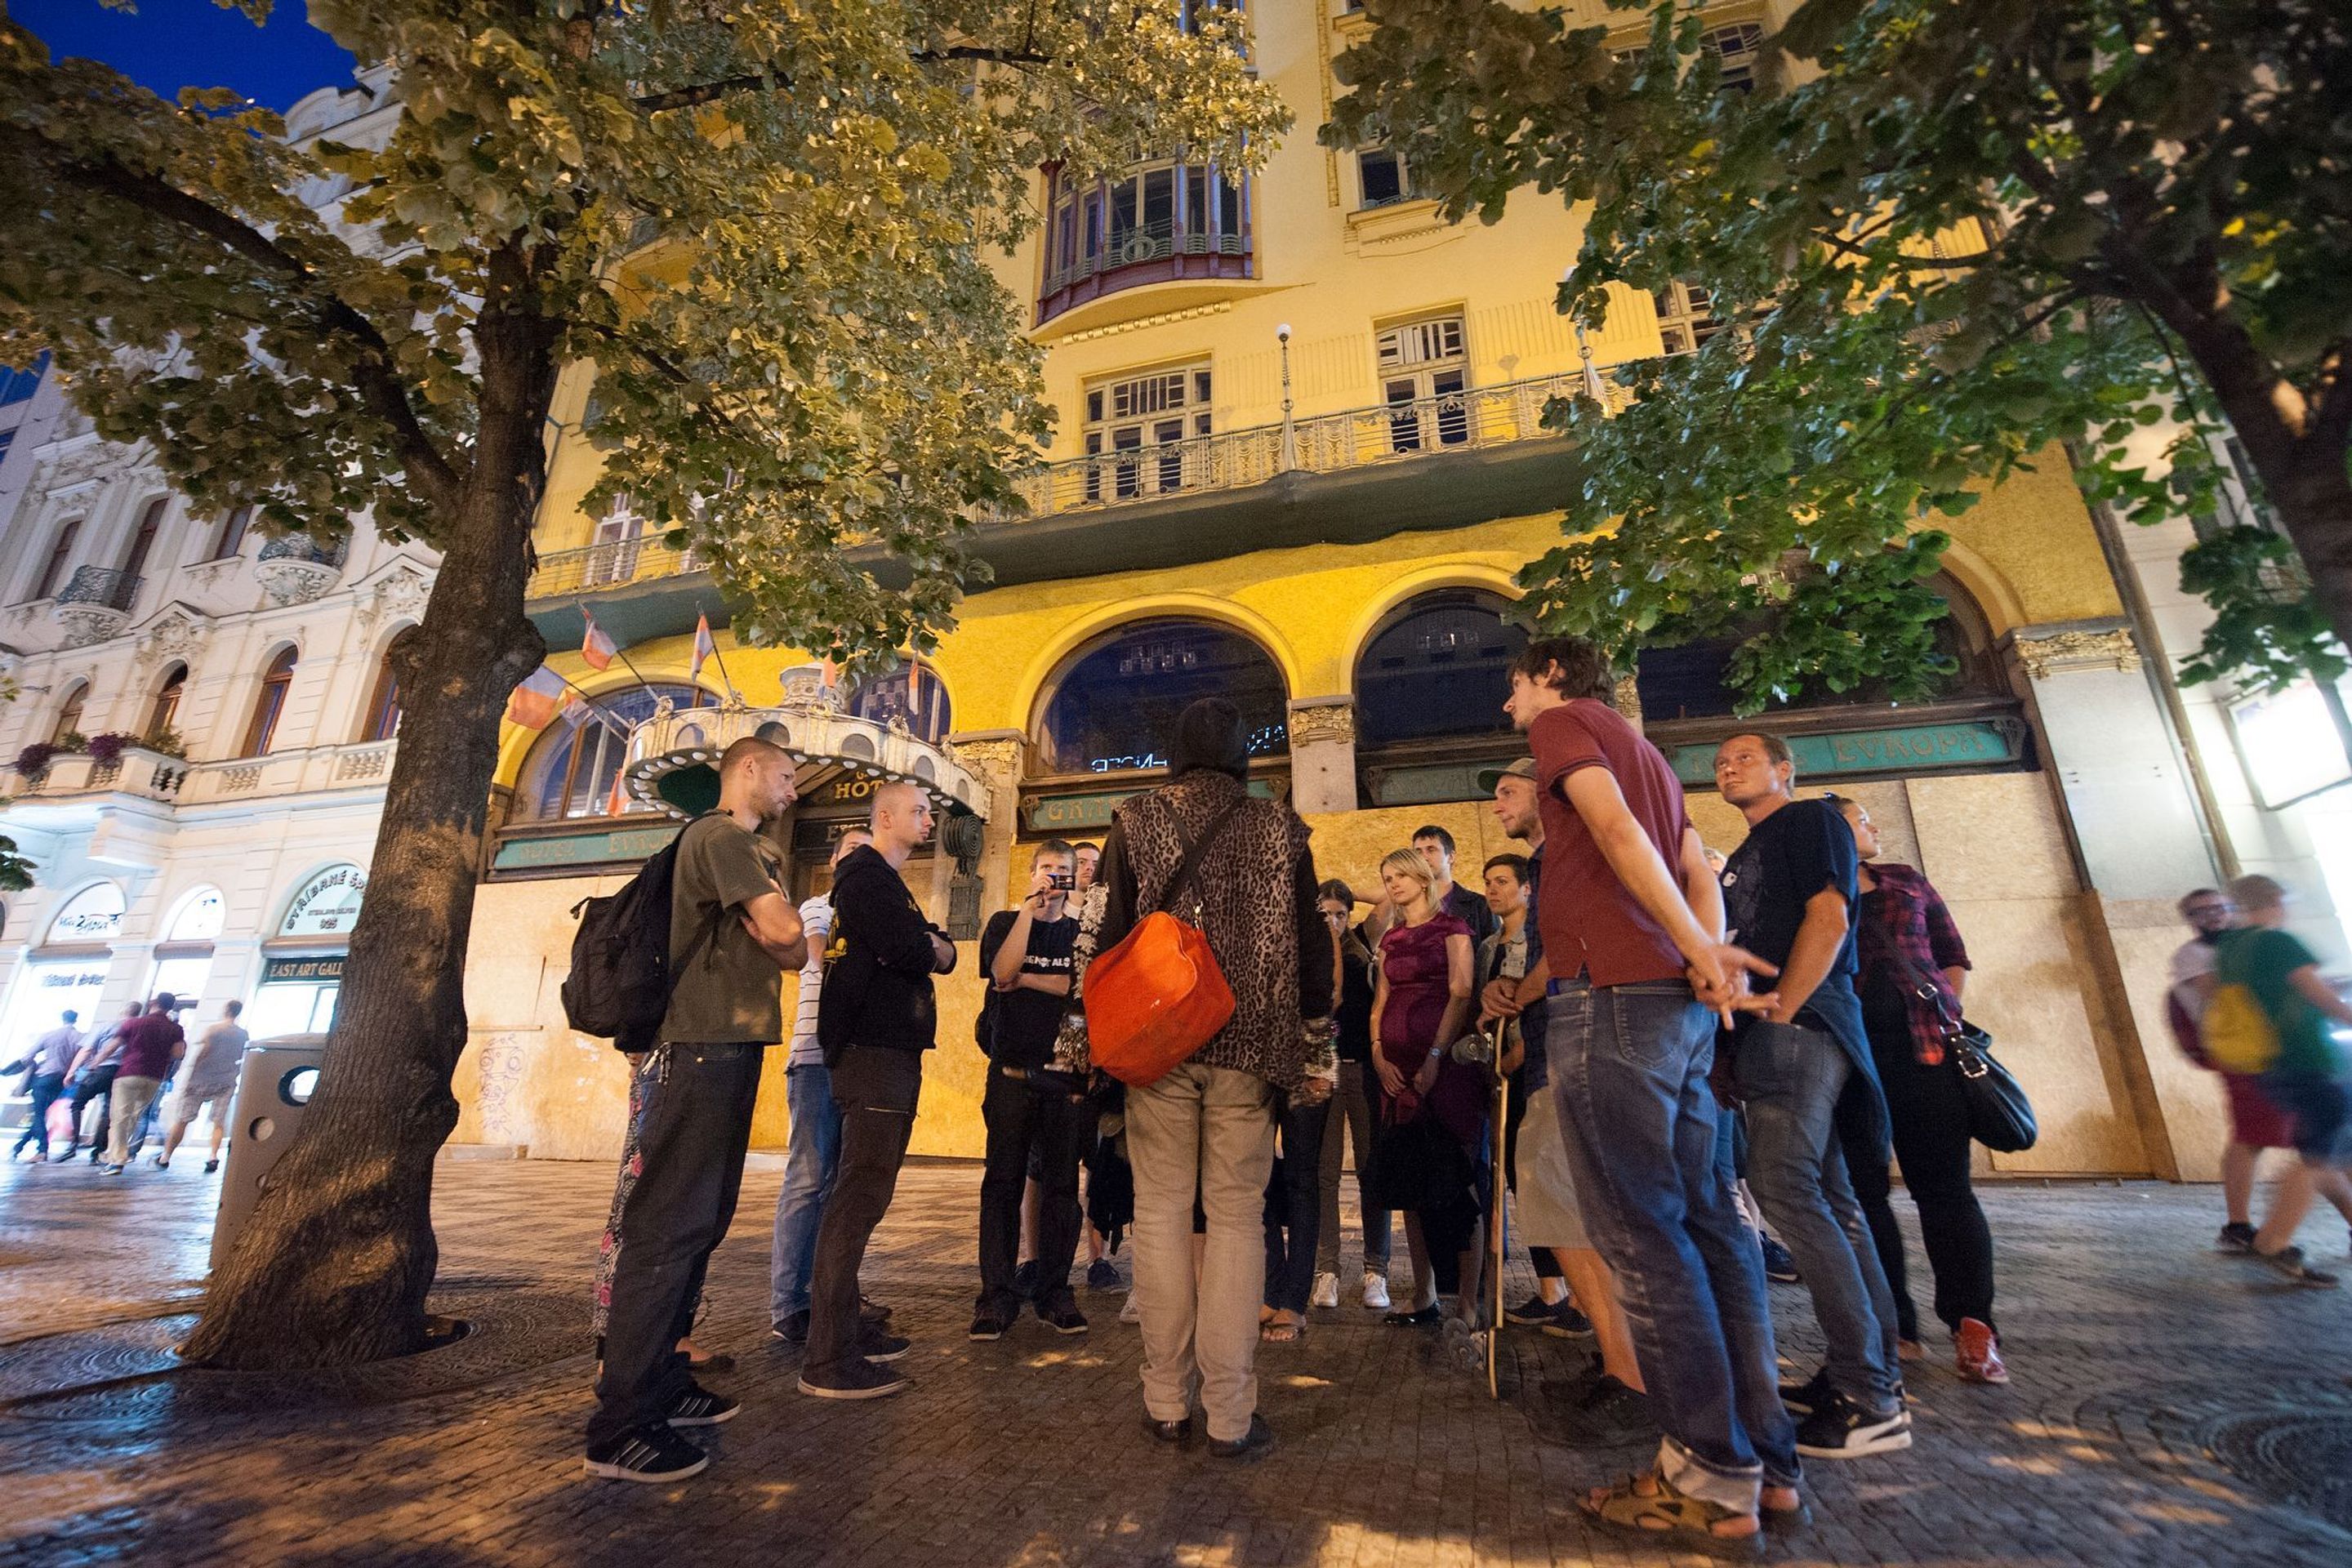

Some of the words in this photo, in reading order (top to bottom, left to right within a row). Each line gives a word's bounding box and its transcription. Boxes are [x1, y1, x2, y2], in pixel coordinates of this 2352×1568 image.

[1835, 726, 1984, 764] EVROPA
[270, 962, 296, 977] EAST
[296, 962, 317, 976] ART
